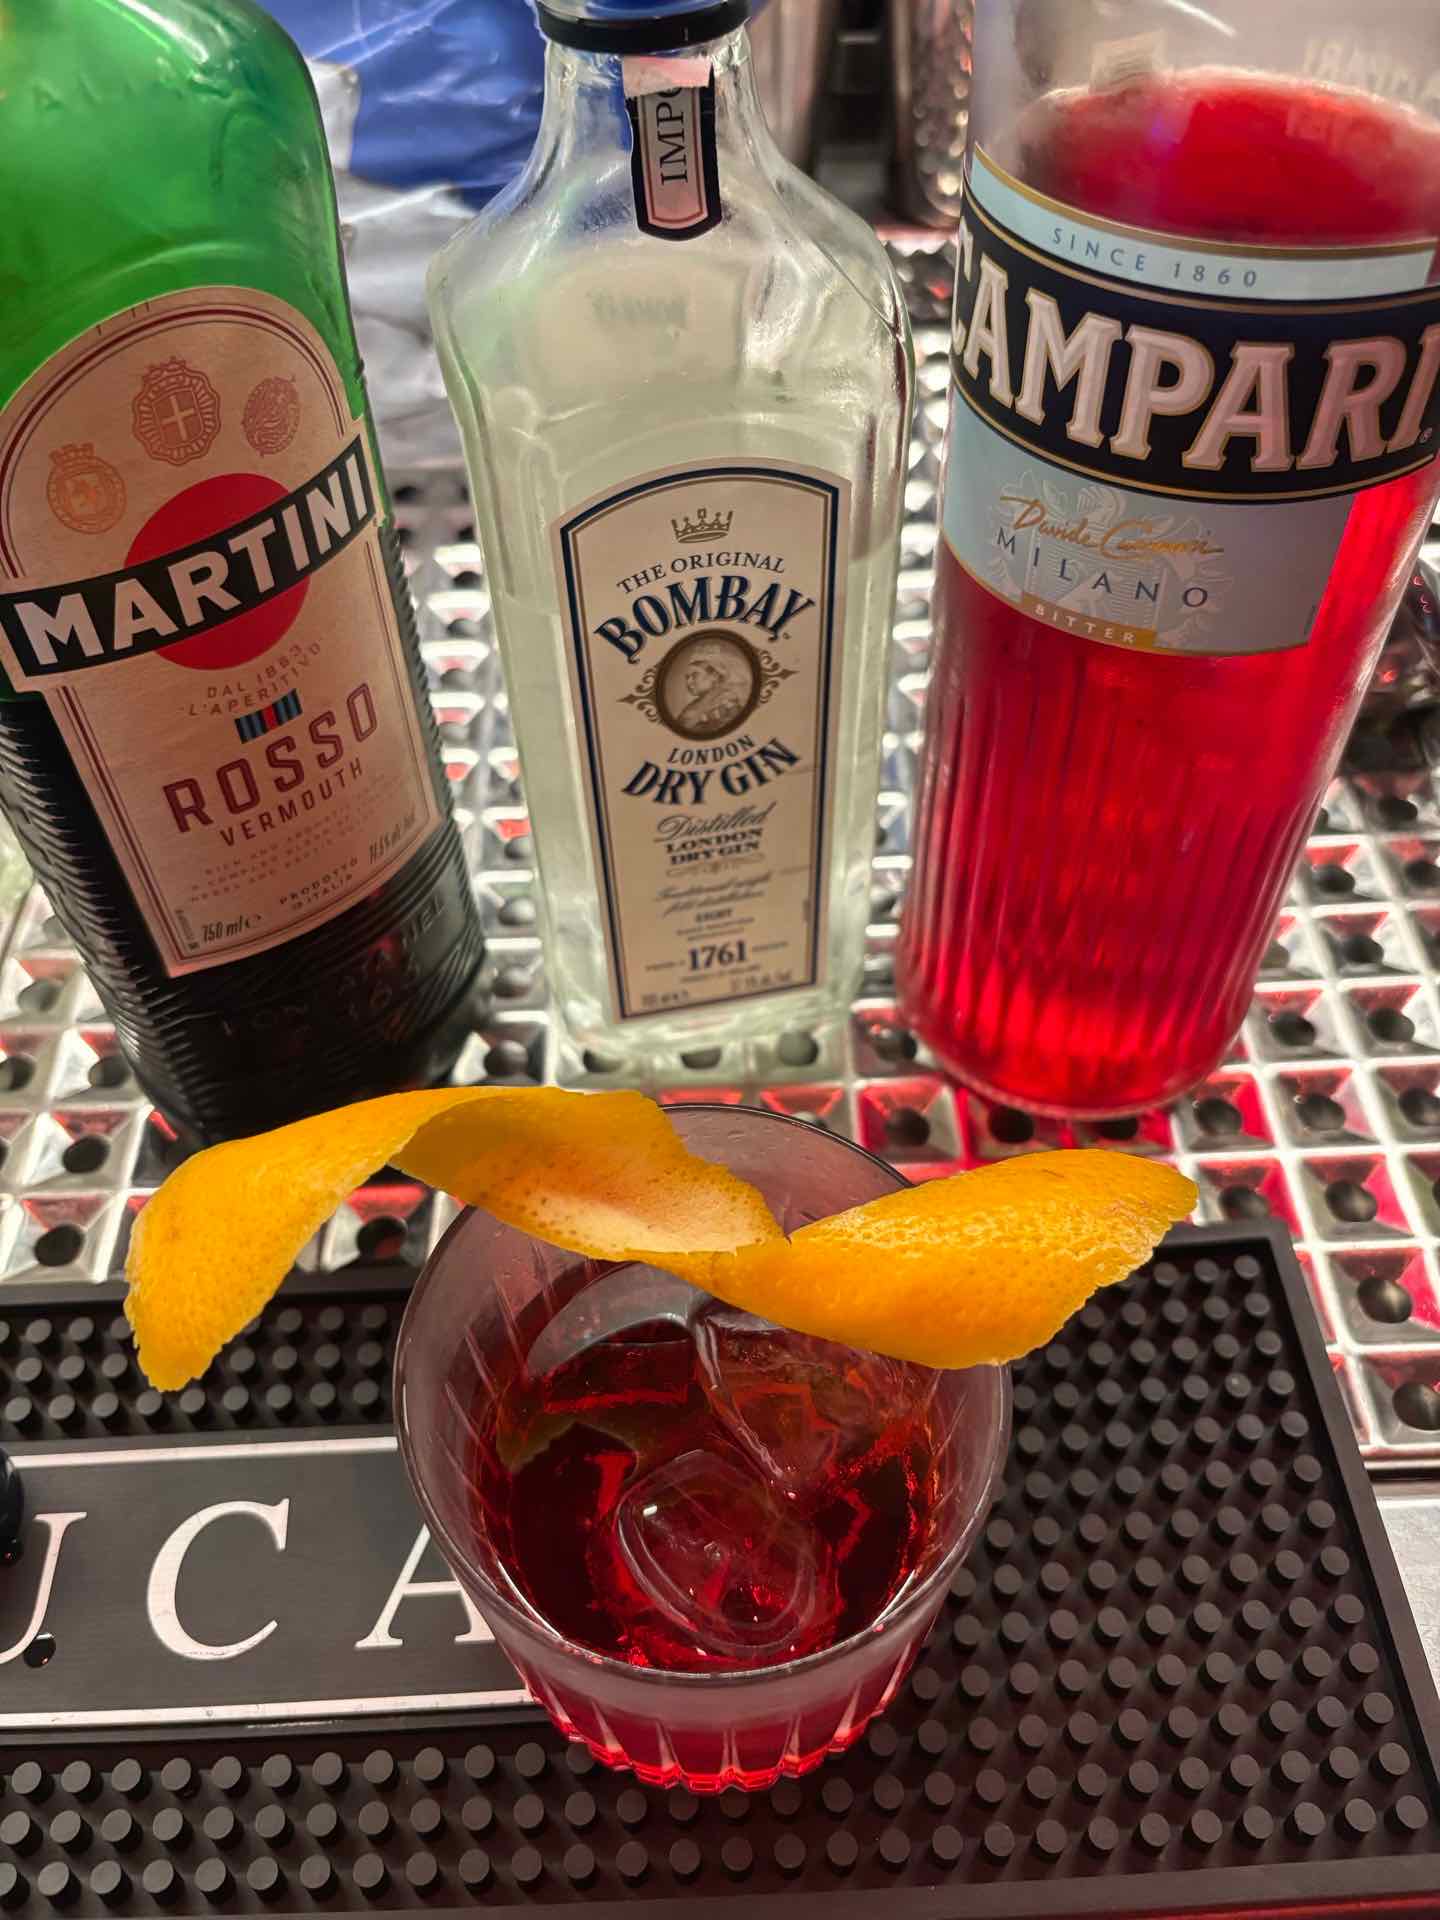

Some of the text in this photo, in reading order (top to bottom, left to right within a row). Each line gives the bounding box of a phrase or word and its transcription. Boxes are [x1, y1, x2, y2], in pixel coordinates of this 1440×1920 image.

[655, 87, 689, 186] IMP
[1051, 227, 1258, 288] SINCE 1860
[951, 215, 1440, 473] CAMPARI
[14, 453, 368, 666] MARTINI
[616, 551, 785, 595] THE ORIGINAL
[996, 526, 1209, 609] MILANO
[592, 574, 817, 665] BOMBAY
[1034, 603, 1137, 644] BITTER
[207, 681, 245, 699] DAL
[162, 682, 378, 833] ROSSO
[620, 737, 802, 805] DRY GIN
[667, 734, 755, 766] LONDON
[219, 757, 363, 847] VERMOUTH
[665, 826, 764, 853] LONDON
[670, 841, 760, 865] DRY GIN
[688, 939, 747, 972] 1761
